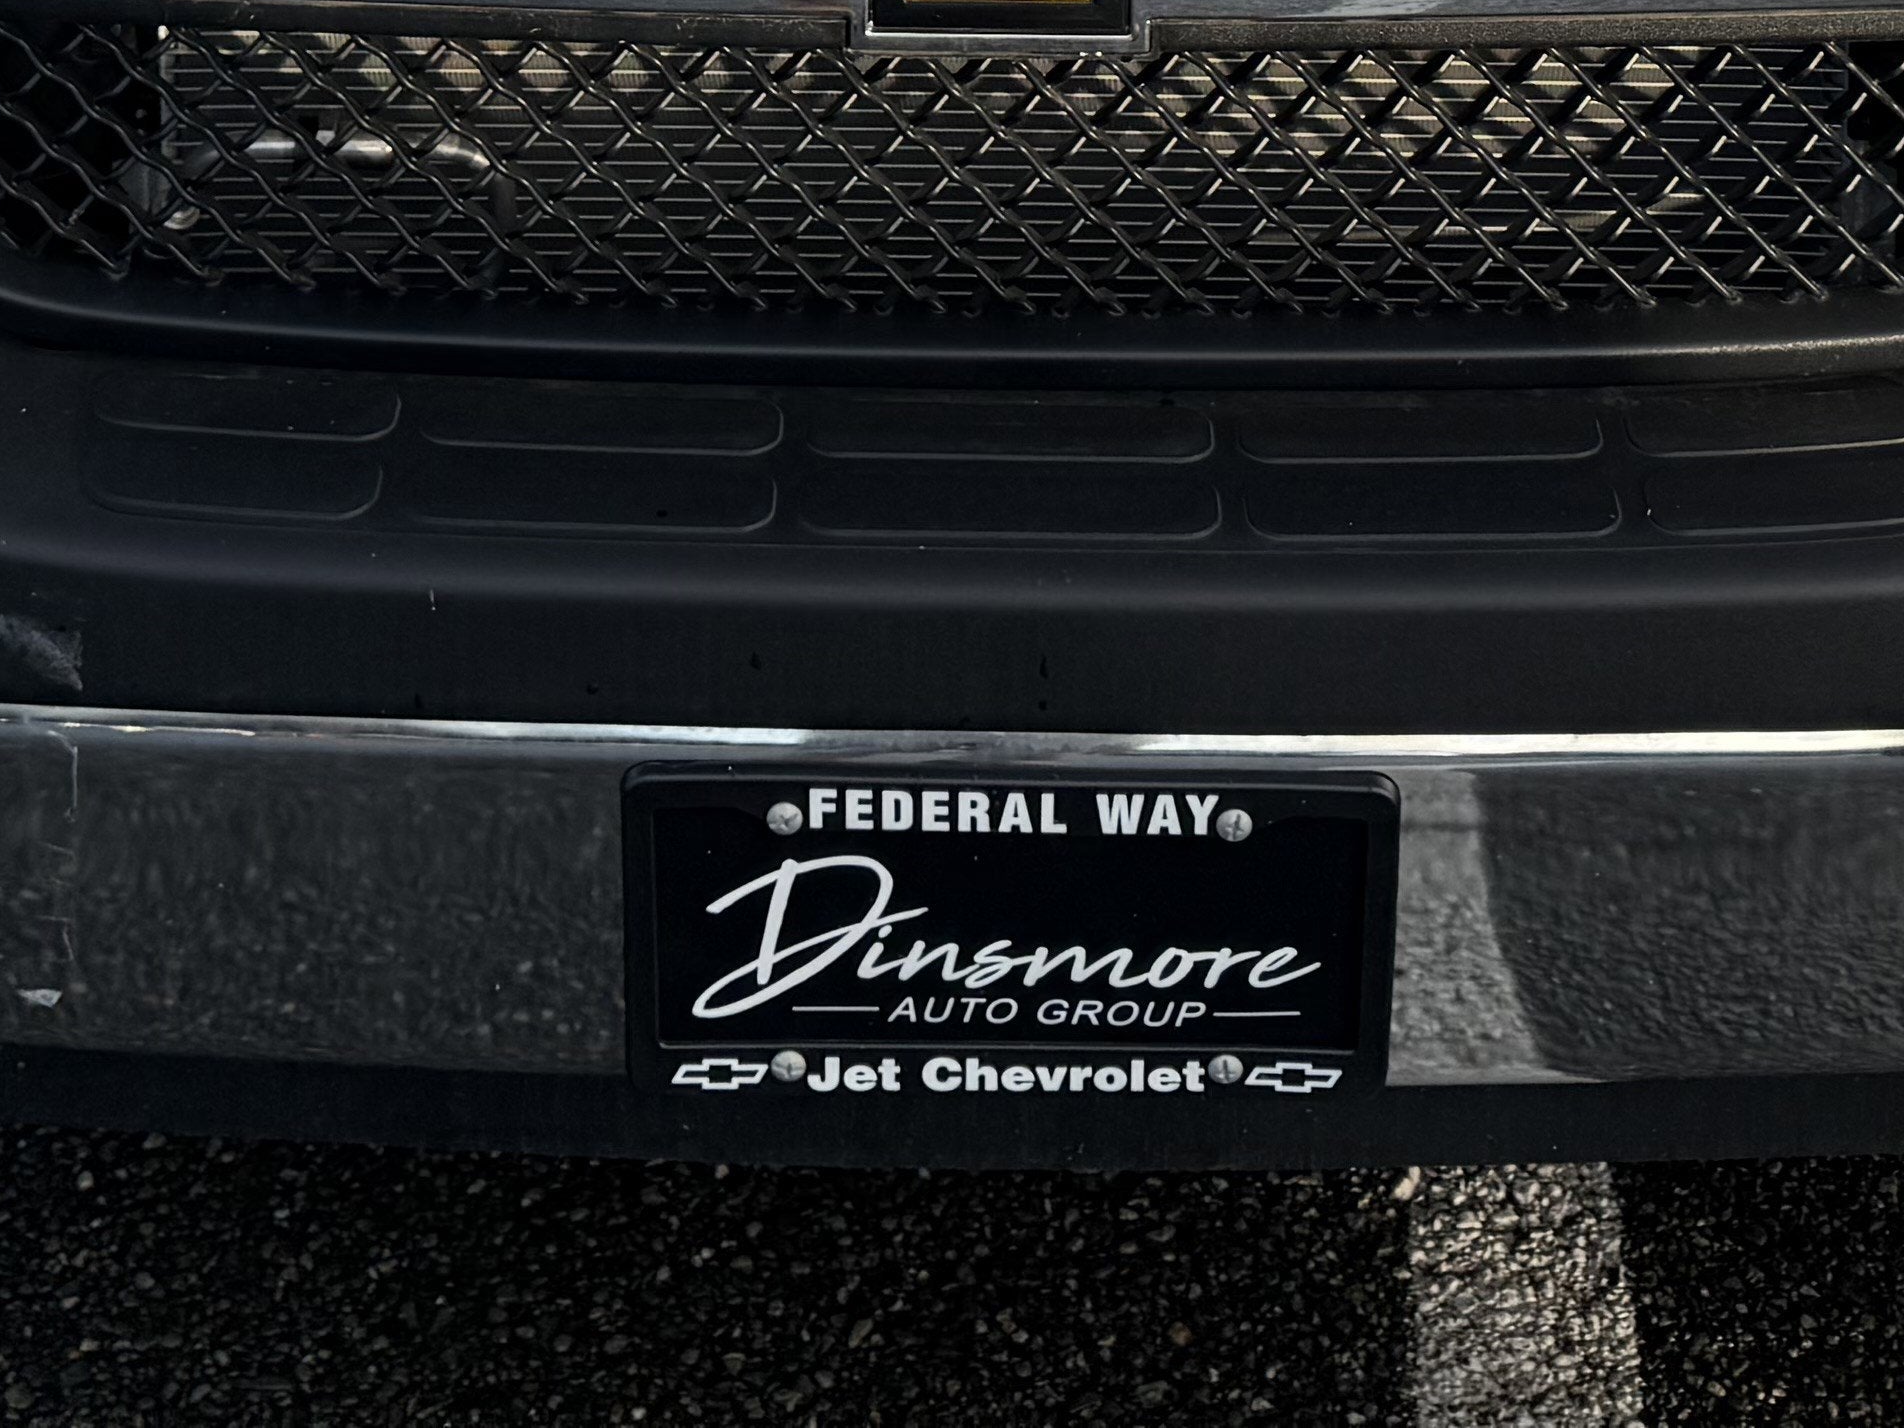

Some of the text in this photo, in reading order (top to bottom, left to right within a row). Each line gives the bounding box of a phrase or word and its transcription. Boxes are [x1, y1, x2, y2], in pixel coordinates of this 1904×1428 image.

[808, 788, 1219, 836] FEDERAL WAY
[691, 855, 1322, 1019] Dinsmore
[887, 996, 1207, 1027] AUTO GROUP
[807, 1056, 1206, 1093] Jet Chevrolet
